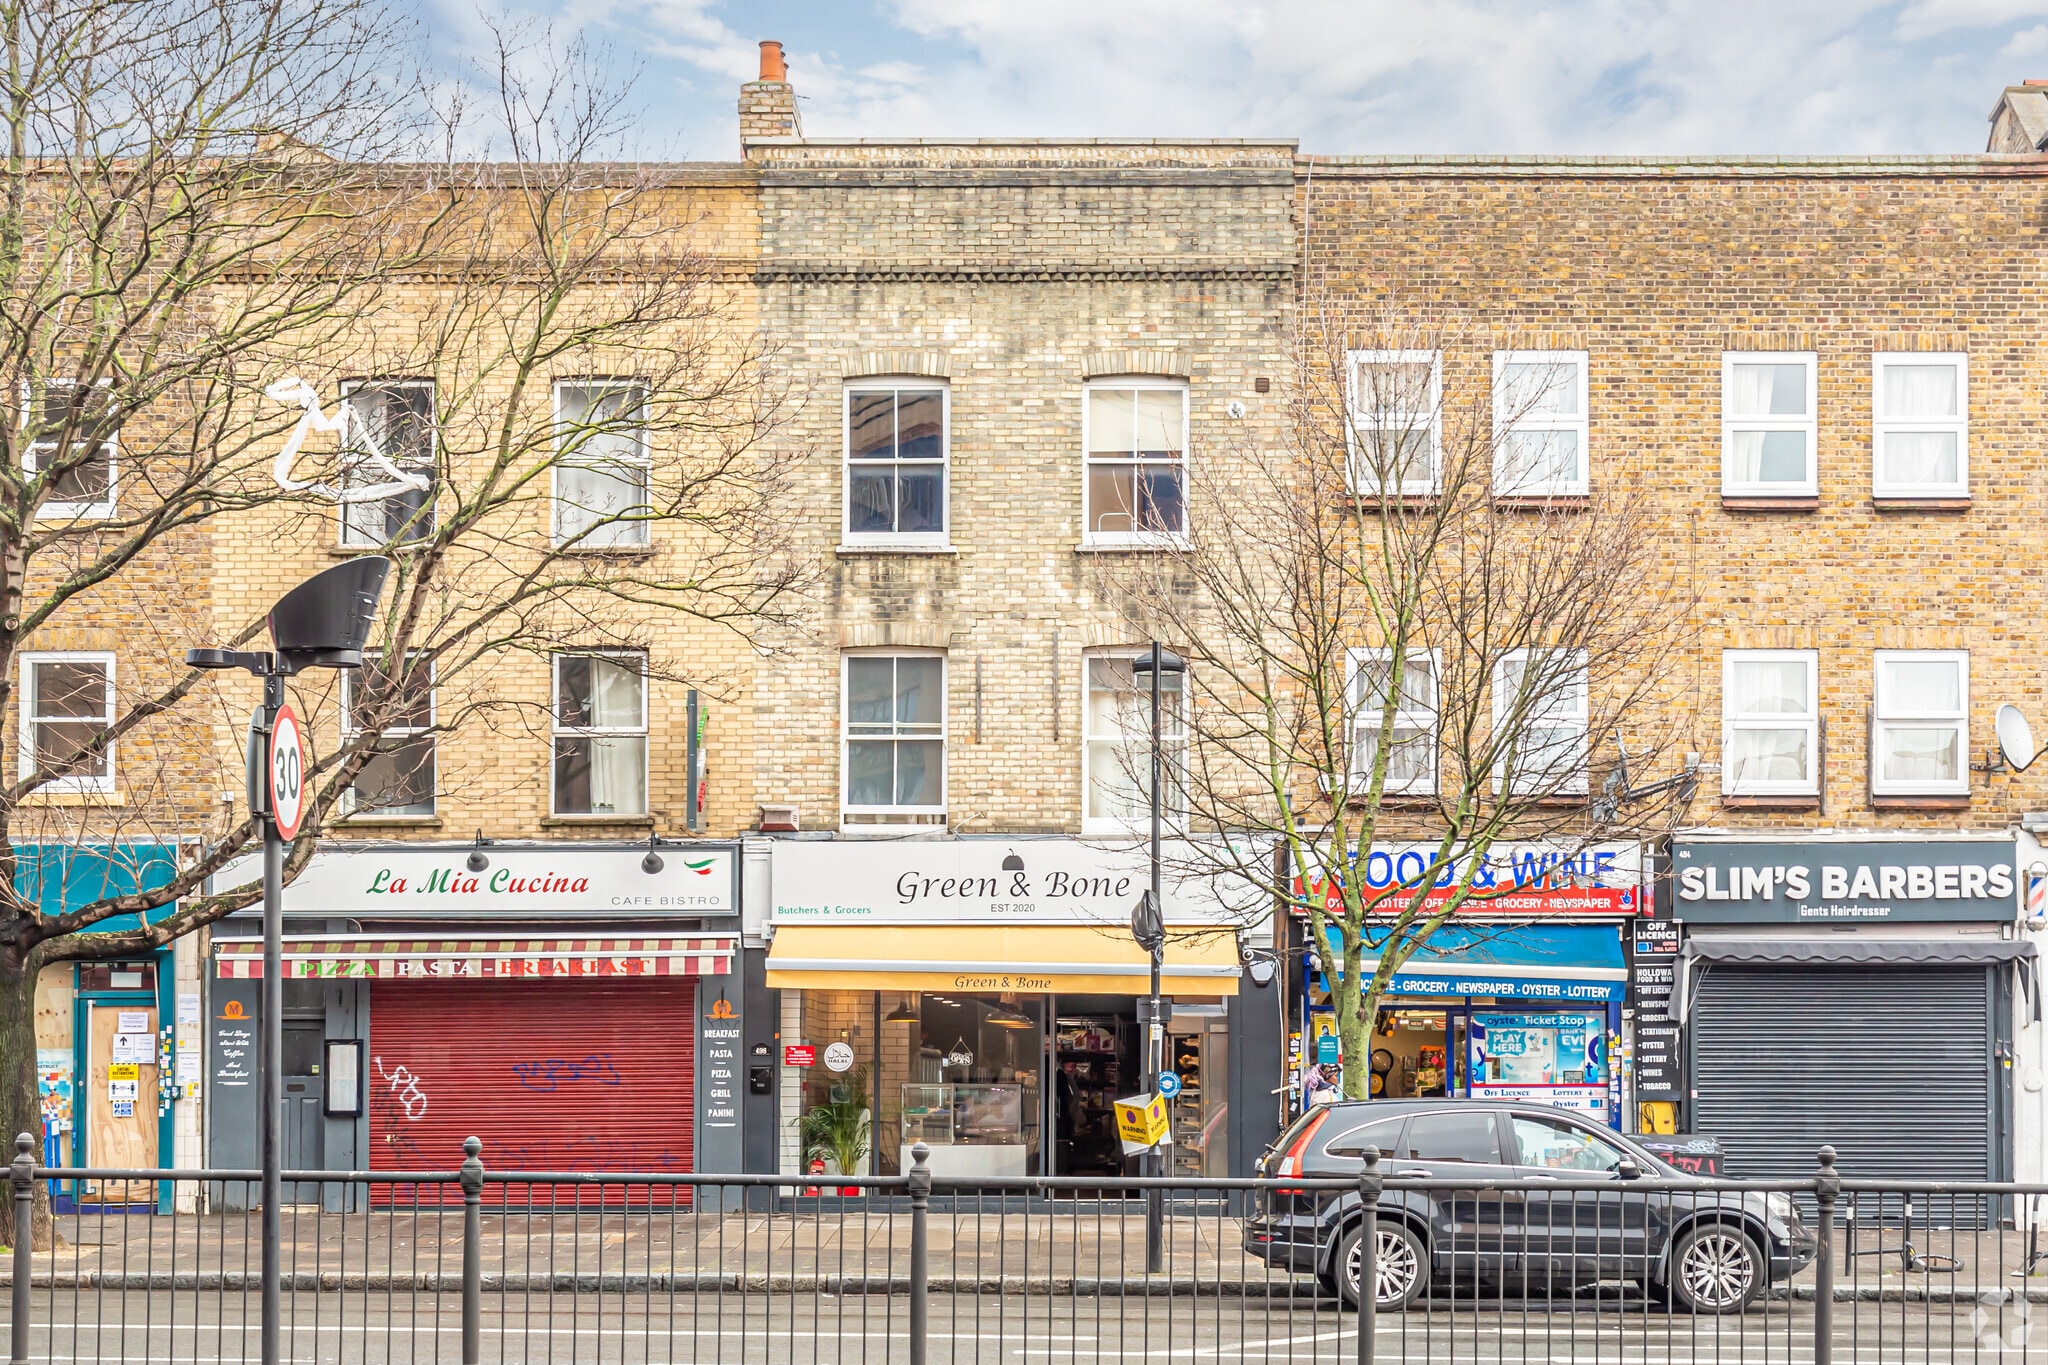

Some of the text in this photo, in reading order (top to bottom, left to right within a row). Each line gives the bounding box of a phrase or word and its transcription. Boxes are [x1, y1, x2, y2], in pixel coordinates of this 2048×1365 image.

[275, 746, 299, 801] 30
[1472, 852, 1498, 888] &
[1510, 851, 1616, 888] WINE
[365, 867, 590, 894] La Mia Cucina
[1678, 866, 1811, 900] SLIM'S
[1821, 864, 2014, 899] BARBERS
[896, 871, 1130, 904] Green & Bone
[611, 896, 720, 905] CAFE BISTRO
[1374, 897, 1414, 908] OTTER
[1424, 897, 1444, 909] OFF
[1495, 898, 1541, 909] GROCERY
[1549, 898, 1611, 909] NEWSPAPER
[778, 905, 872, 914] Butchers & Grocers
[990, 903, 1036, 913] EST 2020
[1800, 904, 1891, 917] Gents Hairdresser
[1647, 922, 1667, 930] OFF
[1636, 931, 1677, 940] LICENCE
[299, 959, 651, 976] PIZZA PASTA BREAKFAST
[1637, 969, 1673, 977] HOLLOWA
[954, 975, 1052, 990] Green & Bone
[1403, 981, 1450, 993] GROCERY
[1456, 982, 1515, 995] NEWSPAPER
[1522, 984, 1561, 996] OYSTER
[1568, 985, 1611, 998] LOTTERY
[1641, 987, 1672, 995] OFF LICEN
[1641, 1000, 1670, 1008] NEWSPAP
[1523, 1014, 1557, 1025] Ticket
[1560, 1014, 1585, 1027] Stop
[704, 1029, 740, 1038] BREAKFAST
[1493, 1034, 1522, 1043] PLAY
[1493, 1043, 1523, 1053] HERE
[1642, 1041, 1665, 1049] OYSTER
[223, 1049, 245, 1058] Coffee
[709, 1049, 733, 1058] PASTA
[1642, 1055, 1667, 1063] LOTTERY
[217, 1069, 249, 1079] Breakfast
[711, 1069, 732, 1078] PIZZA
[1642, 1068, 1663, 1077] WINES
[1642, 1082, 1672, 1090] TOBACCO
[710, 1089, 731, 1098] GRILL
[1553, 1100, 1580, 1108] Oyster
[708, 1109, 734, 1118] PANINI
[1122, 1125, 1147, 1135] WARNING
